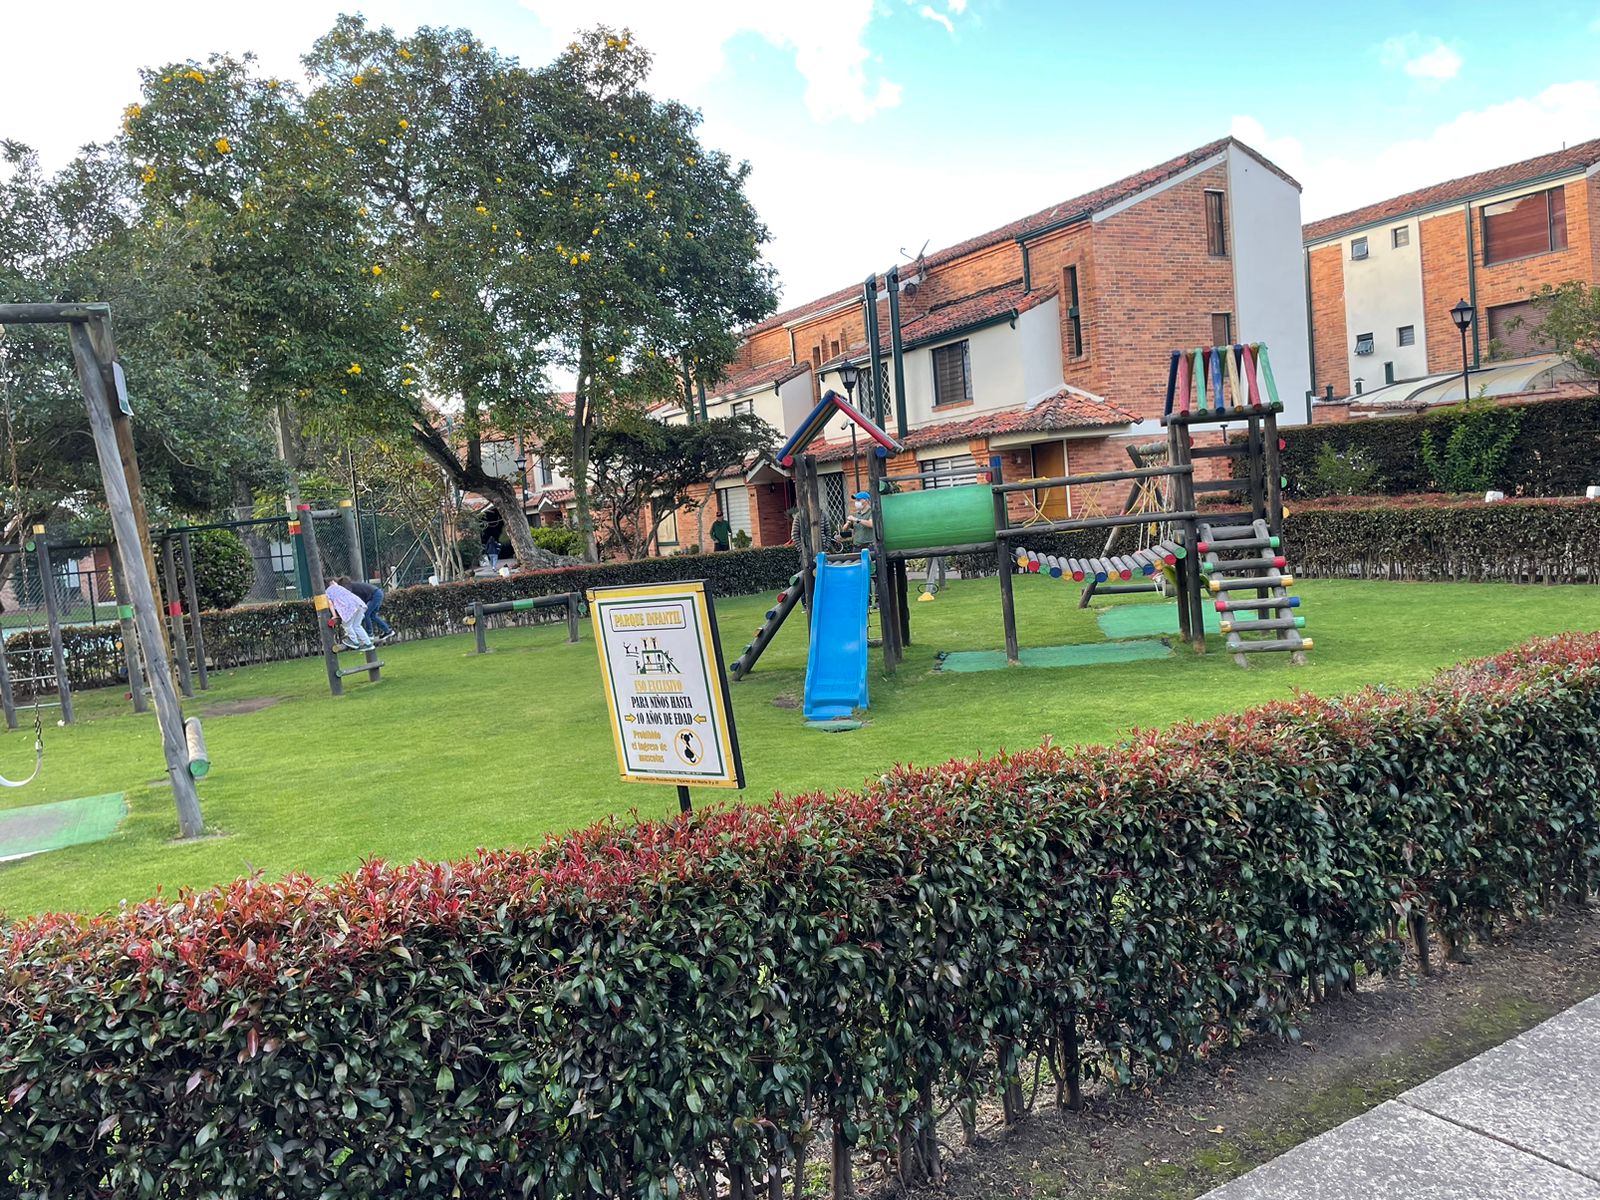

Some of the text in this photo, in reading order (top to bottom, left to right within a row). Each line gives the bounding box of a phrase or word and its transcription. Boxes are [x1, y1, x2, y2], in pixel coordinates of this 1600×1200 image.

[613, 610, 682, 627] PARQUE INFANTIL
[648, 680, 683, 692] EXCLUSIVO
[631, 693, 693, 708] PARA NIÑOS HASTA
[636, 710, 693, 725] 10 AÑOS DE EDAD
